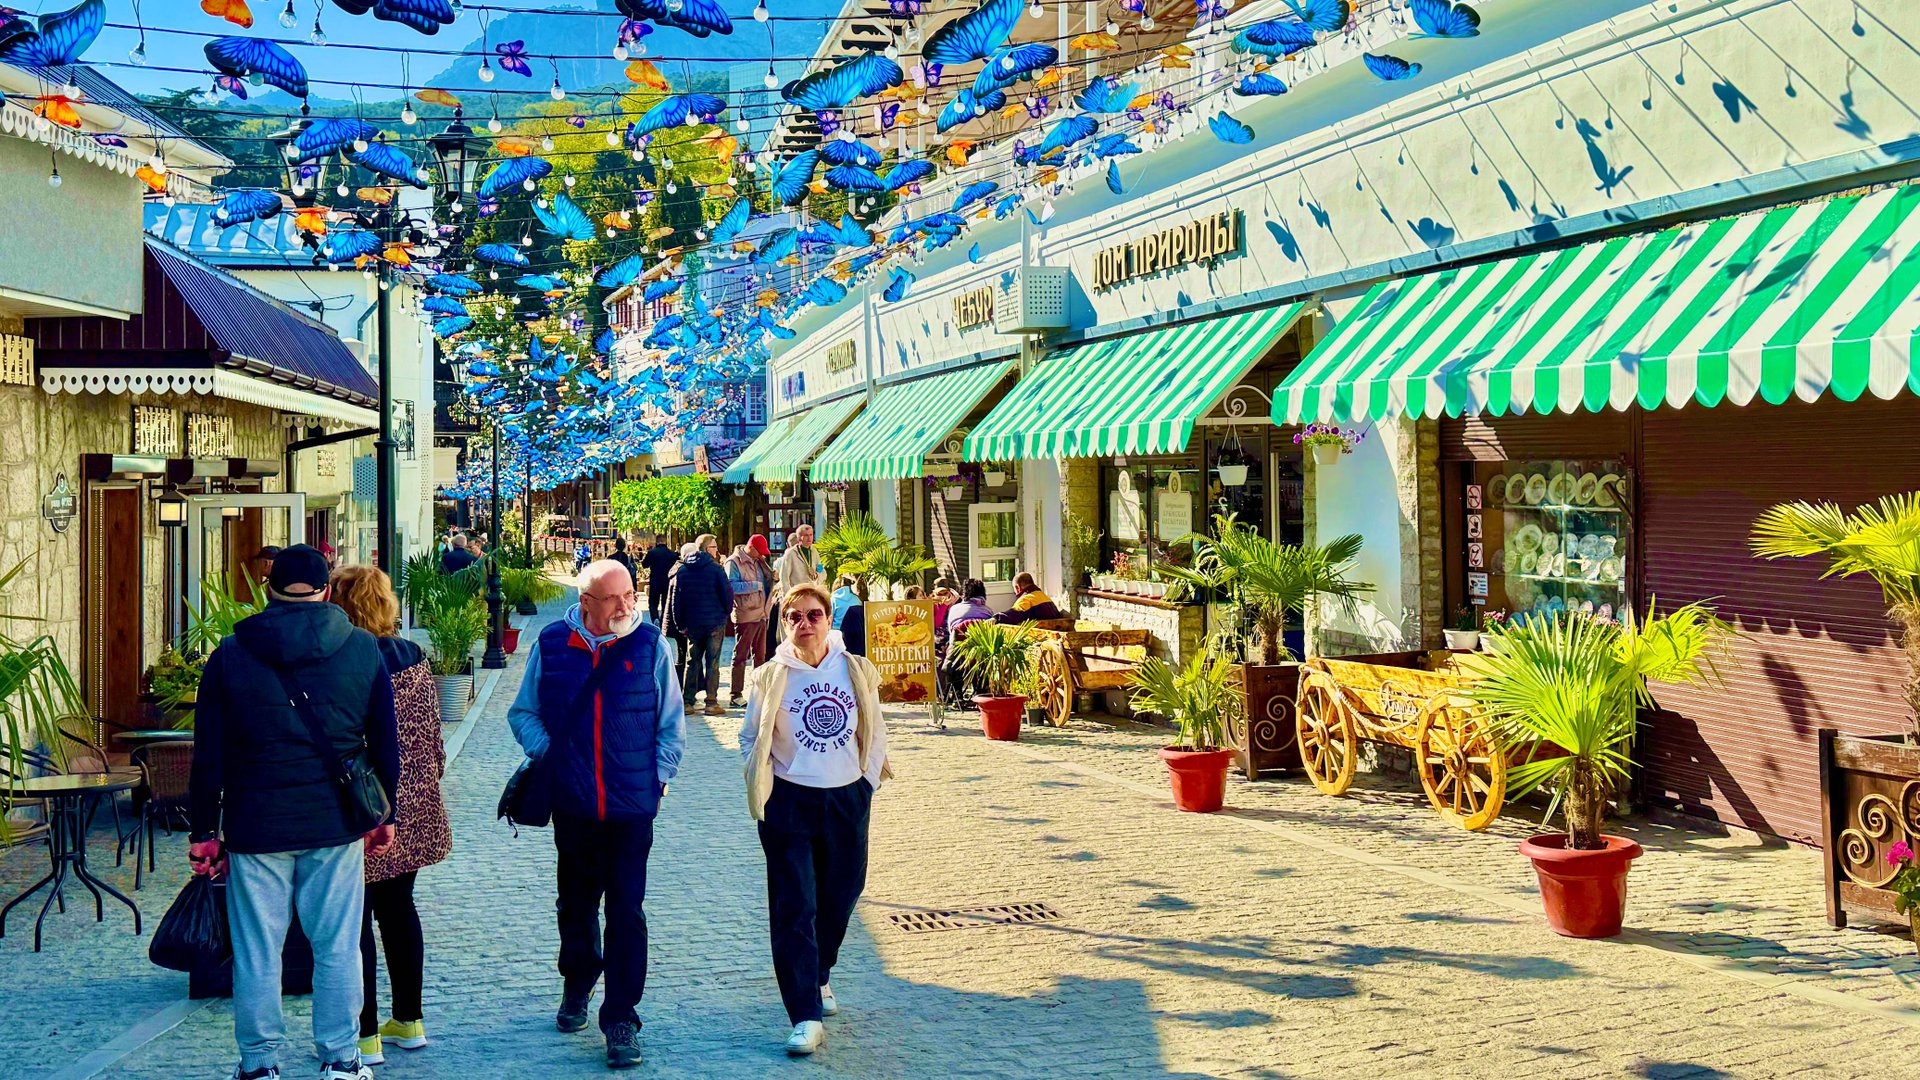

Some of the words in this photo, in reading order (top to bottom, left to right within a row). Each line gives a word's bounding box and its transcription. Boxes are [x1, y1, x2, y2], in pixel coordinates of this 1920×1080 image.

[1092, 243, 1129, 290] ДОМ
[1130, 208, 1238, 277] ПРИРОДЫ
[903, 604, 928, 620] ГУЛИ
[872, 645, 930, 662] ЧЕБУРЕКИ
[898, 663, 904, 674] В
[906, 662, 931, 674] ТУРКЕ
[789, 698, 806, 714] U.S.
[803, 682, 830, 698] POLO
[831, 686, 855, 713] ASSN.
[795, 730, 827, 753] SINCE
[833, 728, 853, 750] 1890
